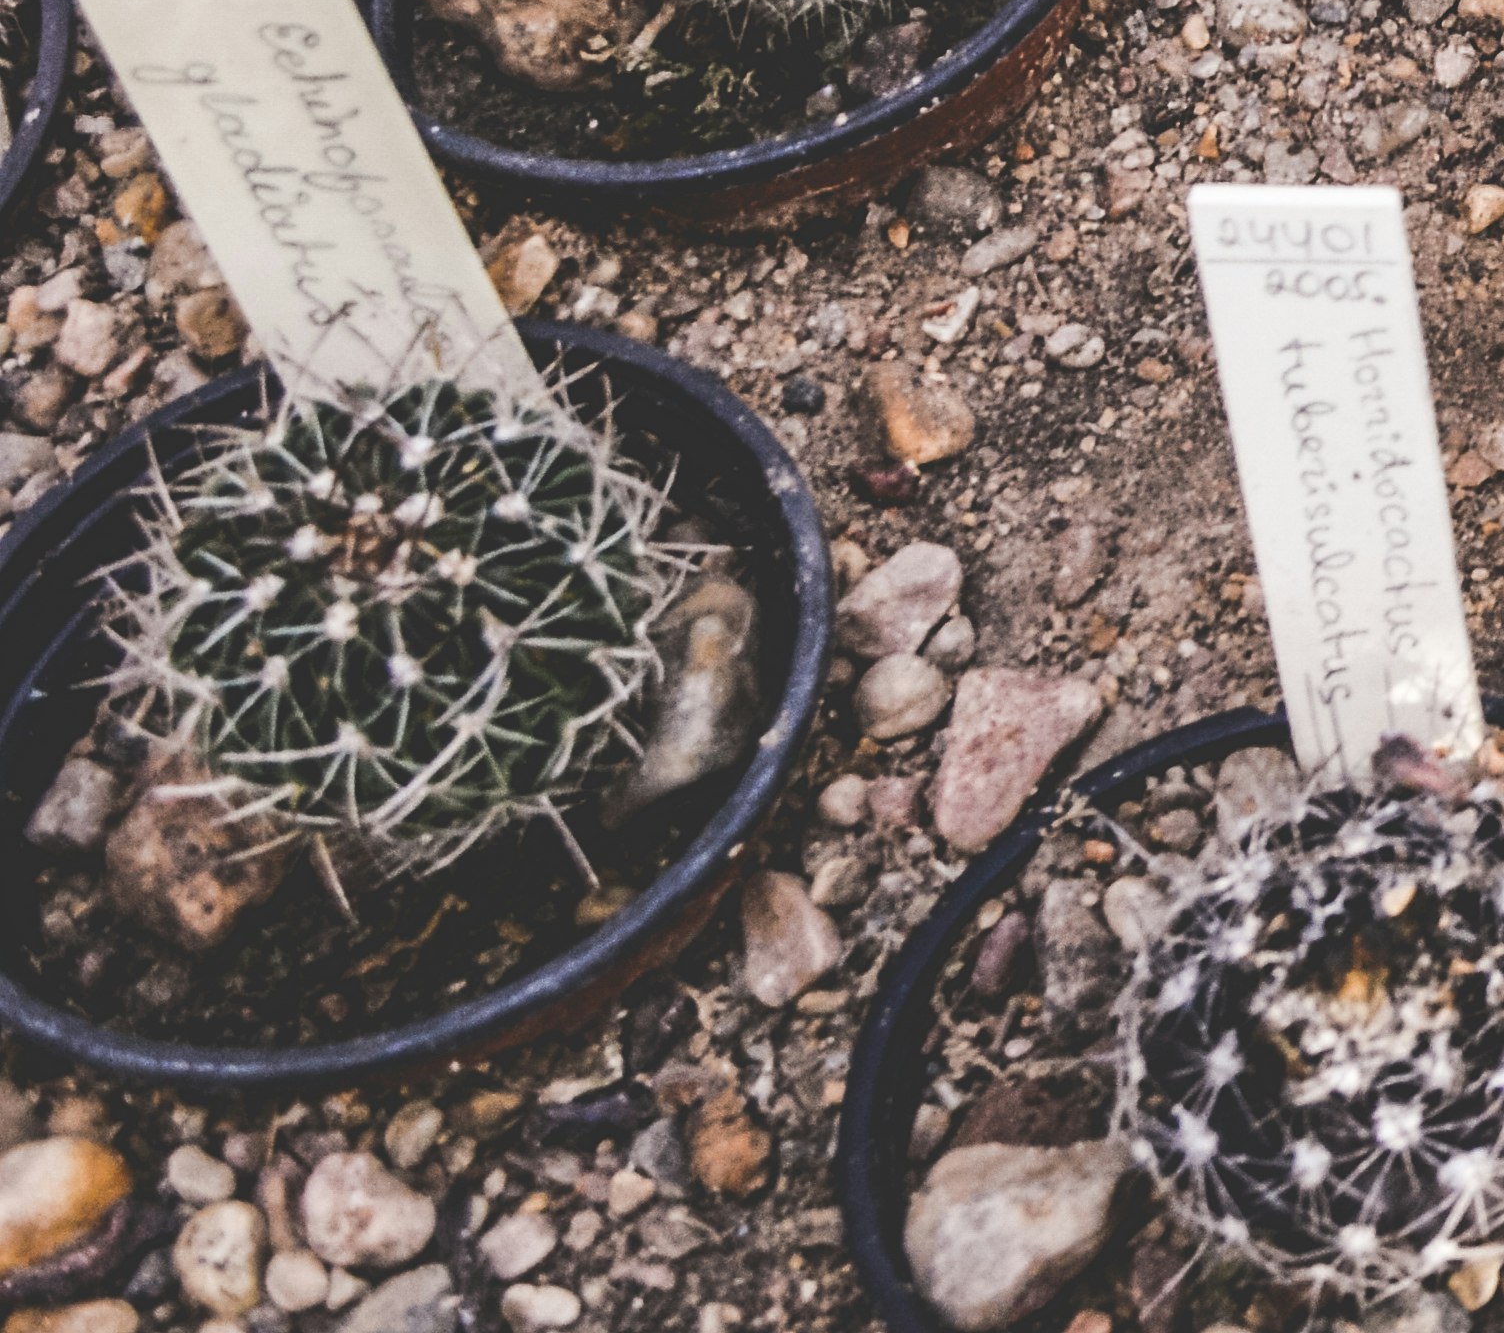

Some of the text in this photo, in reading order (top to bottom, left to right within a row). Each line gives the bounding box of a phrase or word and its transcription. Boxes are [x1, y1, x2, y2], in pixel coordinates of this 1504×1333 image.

[128, 60, 378, 336] gladiatus
[1213, 214, 1373, 256] 24401
[1276, 335, 1391, 708] tuberisulcatus
[1346, 327, 1439, 658] Horridocactus
